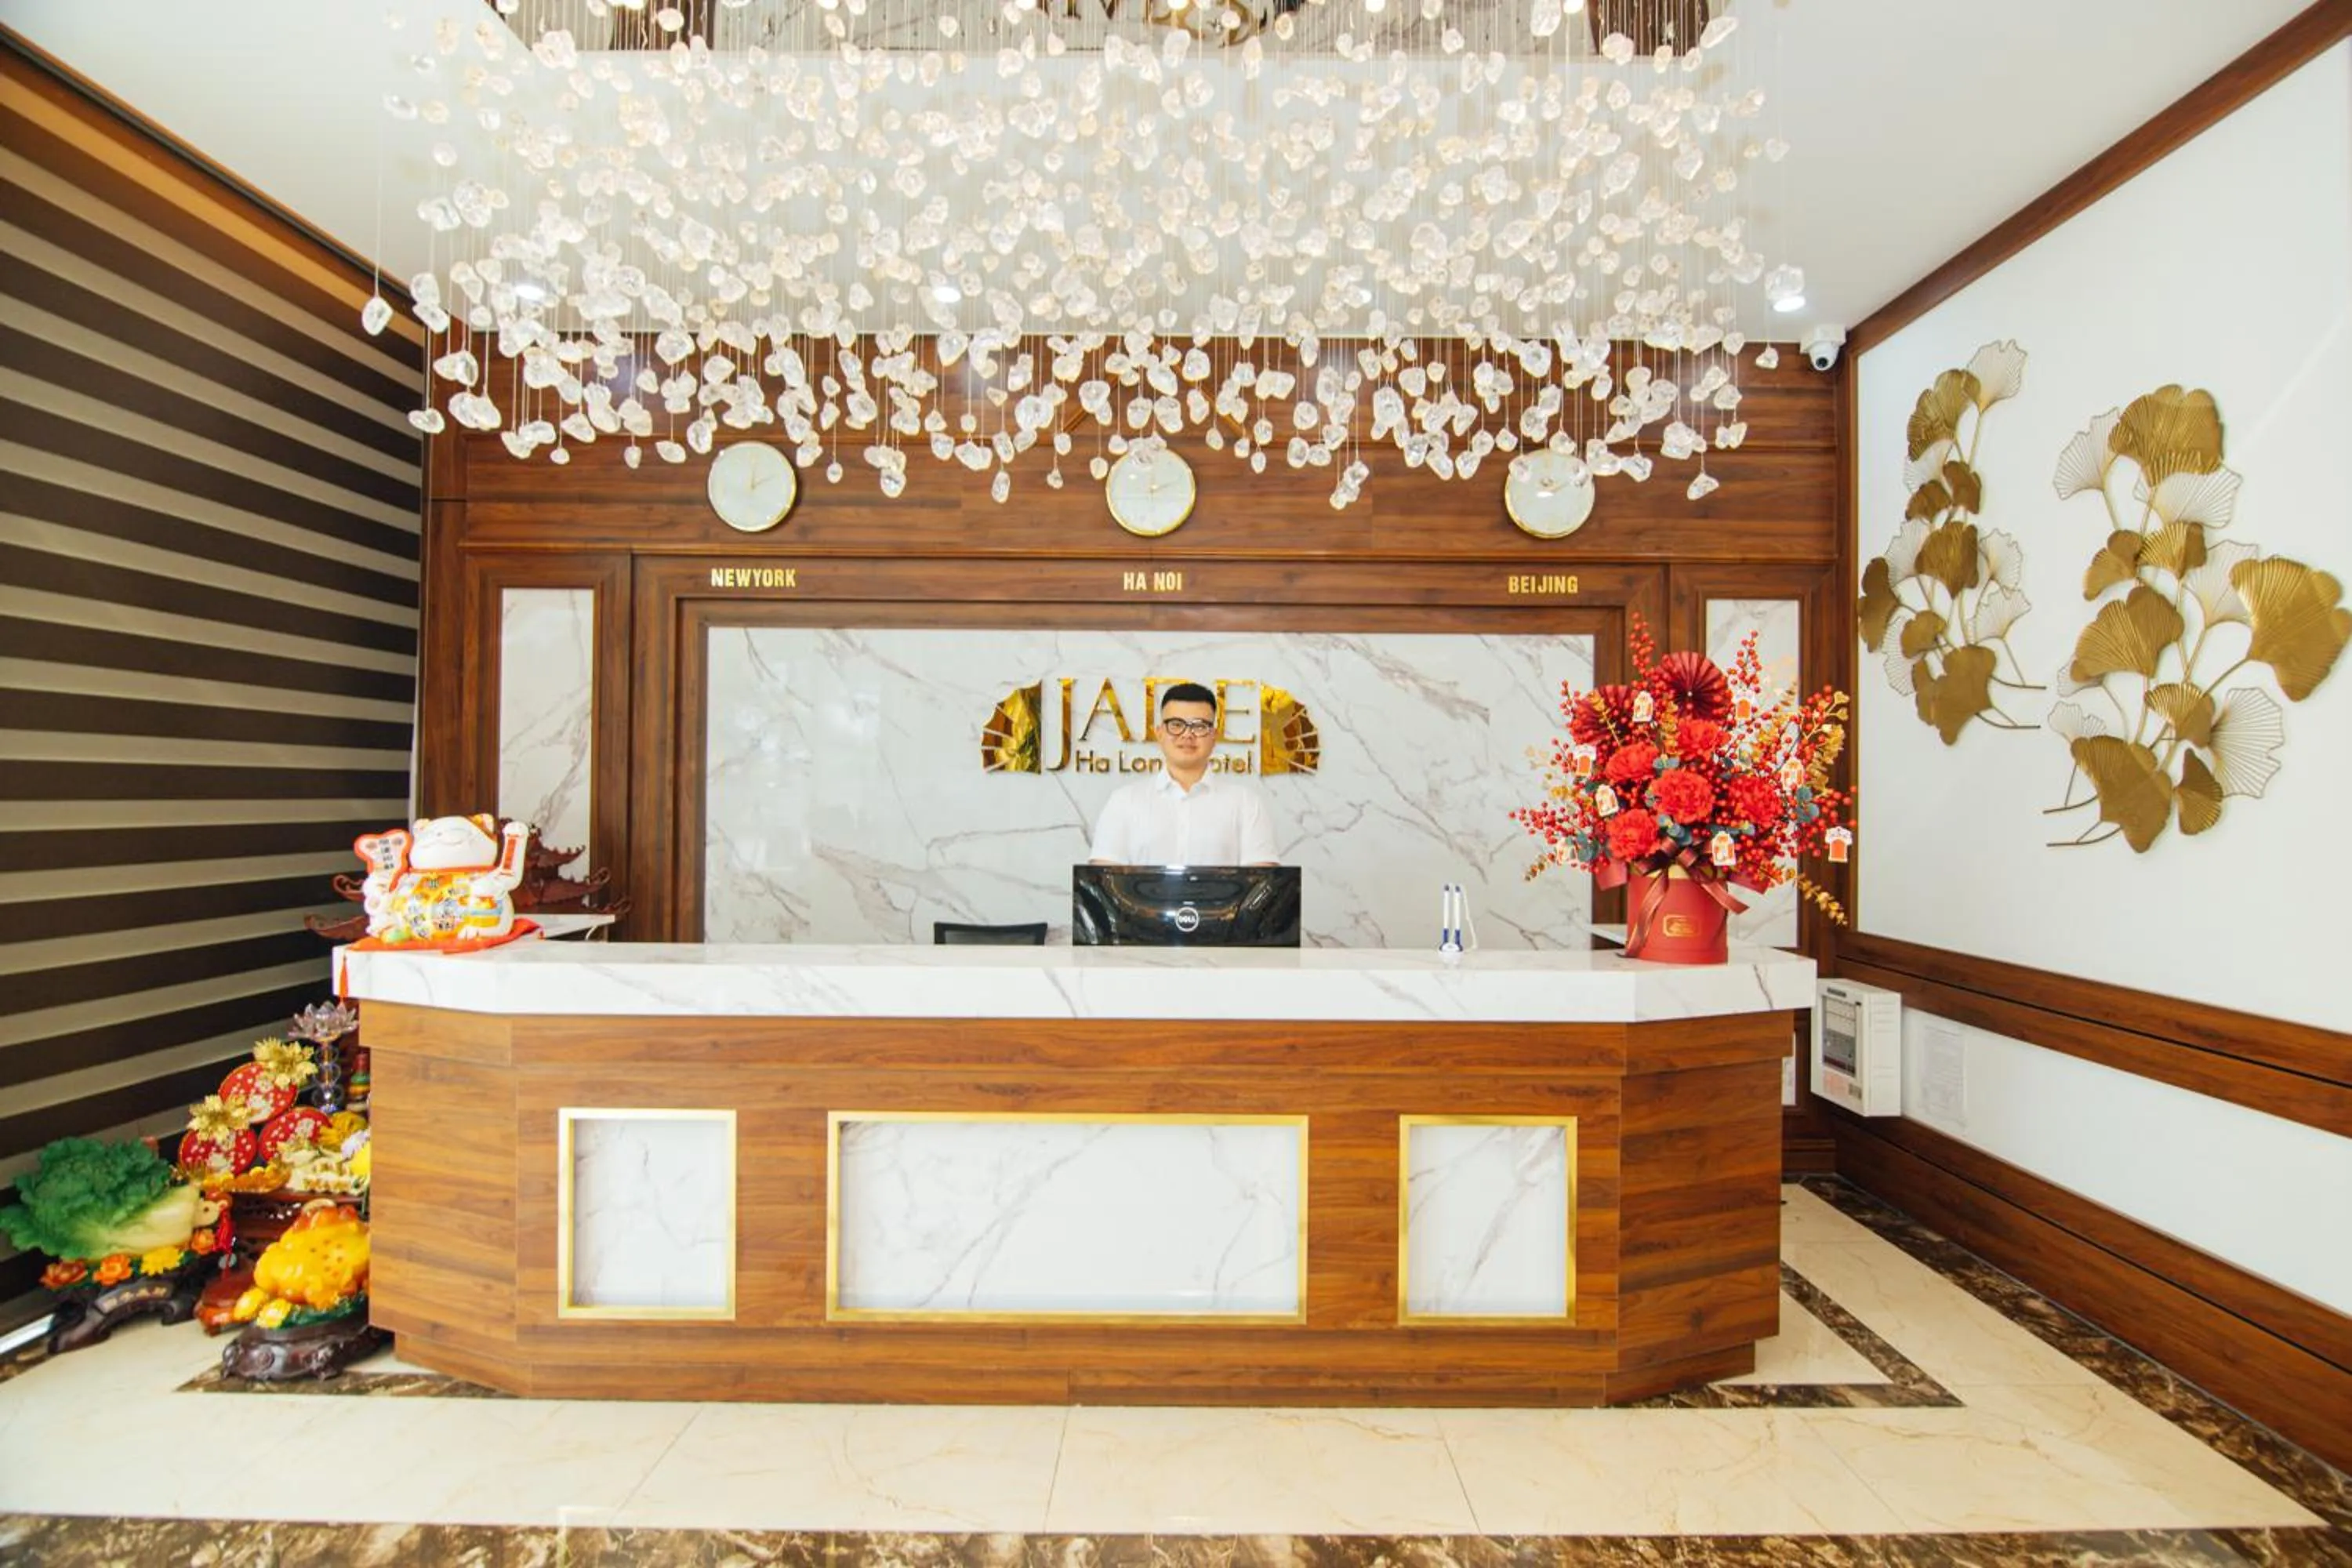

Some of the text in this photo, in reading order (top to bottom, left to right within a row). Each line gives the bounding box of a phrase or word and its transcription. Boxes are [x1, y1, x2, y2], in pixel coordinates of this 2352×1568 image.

[710, 568, 796, 587] NEWYORK
[1123, 572, 1181, 591] HA NOI
[1508, 575, 1578, 593] BEIJING
[1075, 750, 1252, 774] Ha Lon otel
